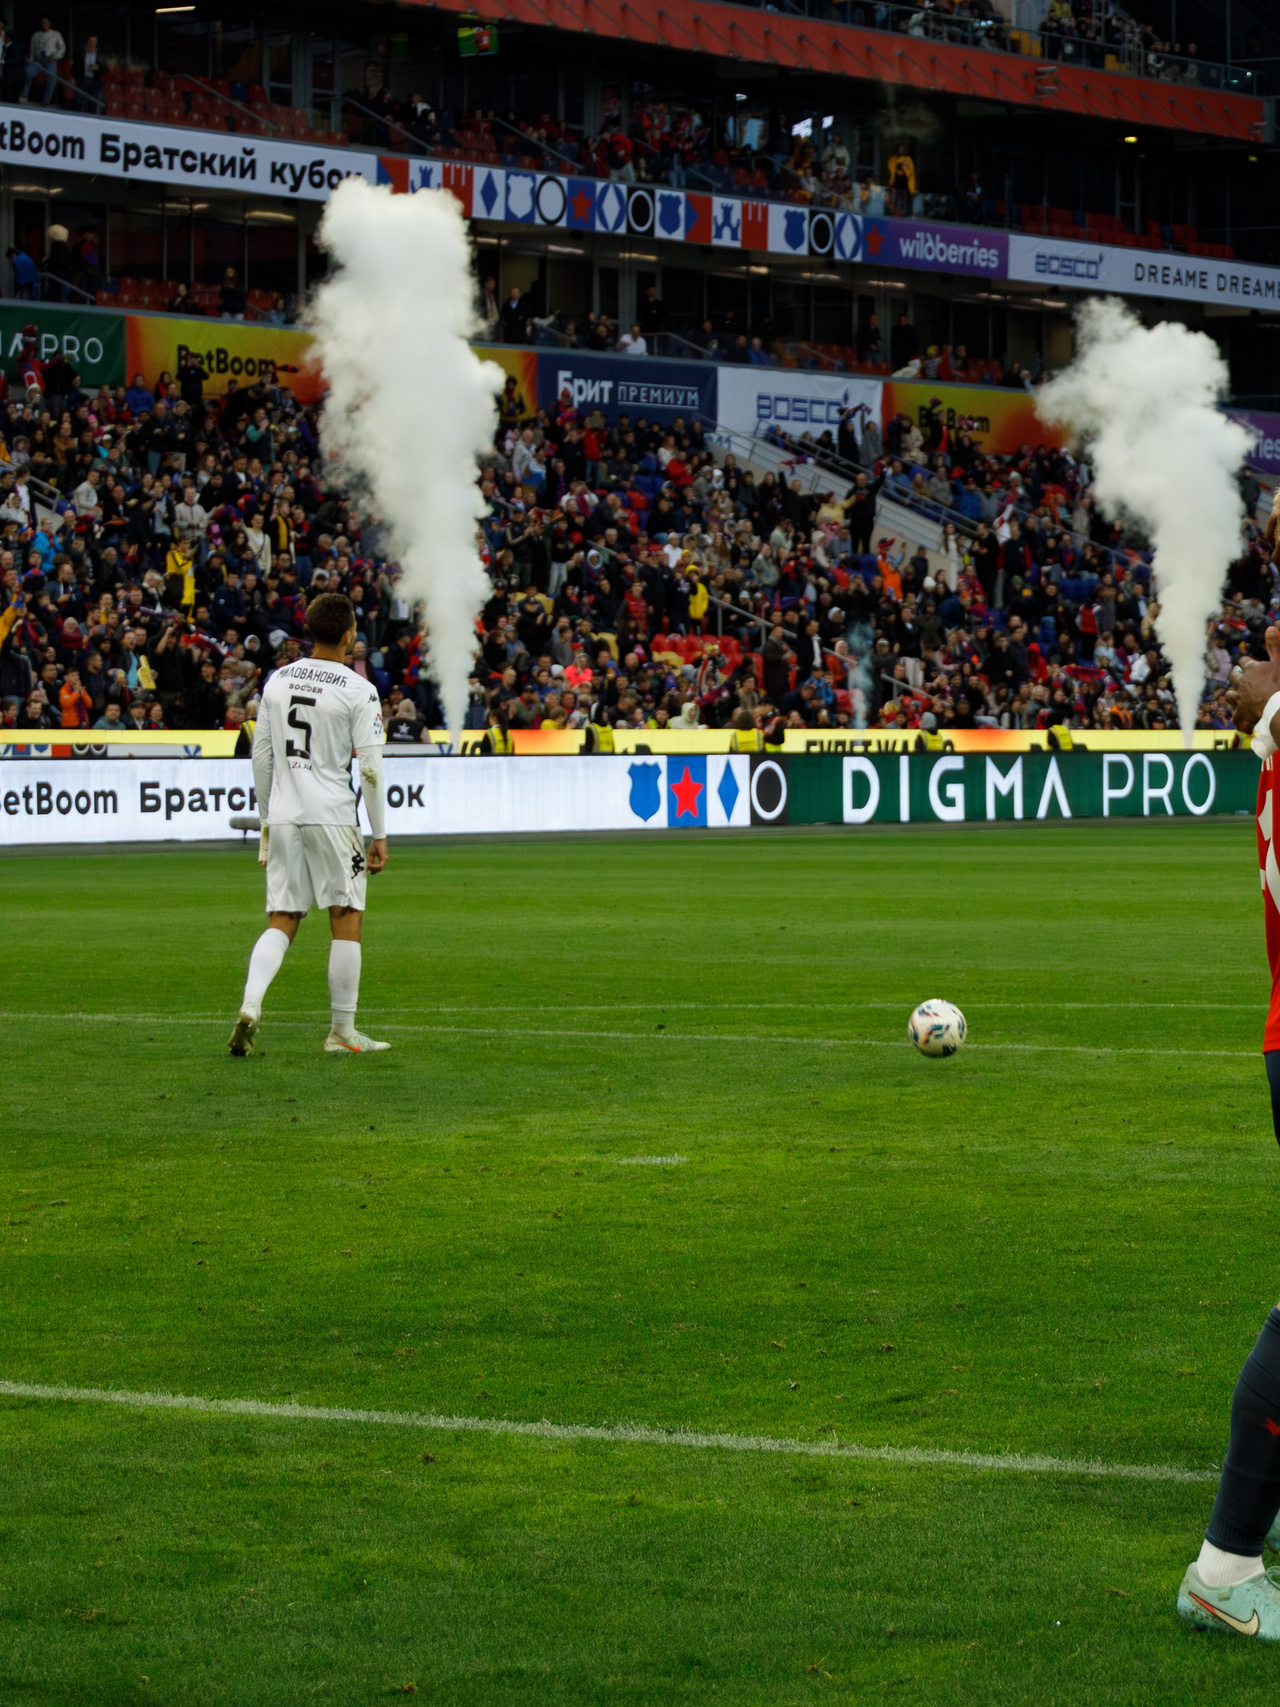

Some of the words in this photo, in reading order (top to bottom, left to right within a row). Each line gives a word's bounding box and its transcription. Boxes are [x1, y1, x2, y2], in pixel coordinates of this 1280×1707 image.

[100, 133, 256, 180] Братский
[899, 231, 999, 269] wildberries
[1034, 253, 1099, 280] BOSCO
[1134, 262, 1208, 290] DREAME
[41, 333, 103, 364] PRO
[557, 370, 614, 408] Брит
[617, 384, 700, 406] ПРЕМИУМ
[285, 694, 317, 760] 5
[0, 781, 118, 816] etBoom
[842, 754, 1073, 824] DIGMA
[1102, 753, 1216, 818] PRO
